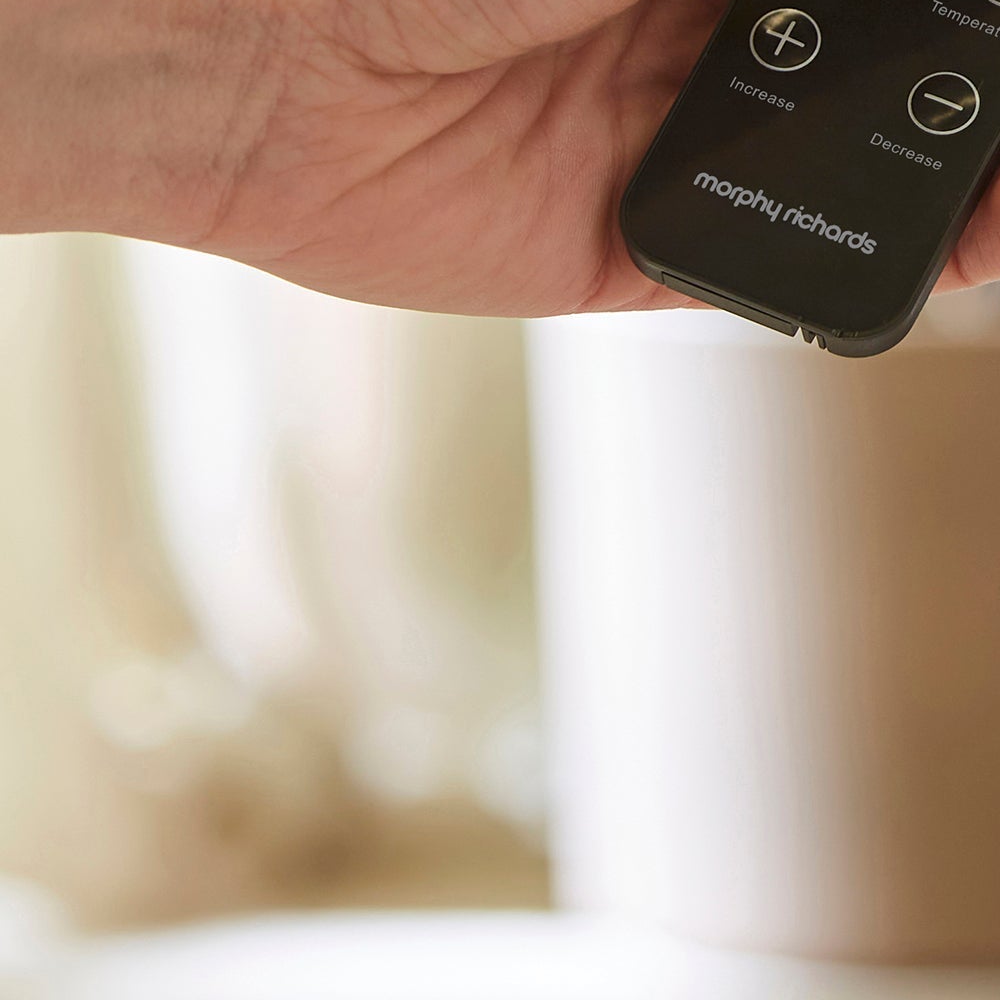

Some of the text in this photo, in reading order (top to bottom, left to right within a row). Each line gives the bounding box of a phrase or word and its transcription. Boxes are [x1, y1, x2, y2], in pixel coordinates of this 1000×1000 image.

[729, 76, 795, 112] Increase
[870, 132, 943, 171] Decrease
[693, 172, 878, 255] morphy richards
